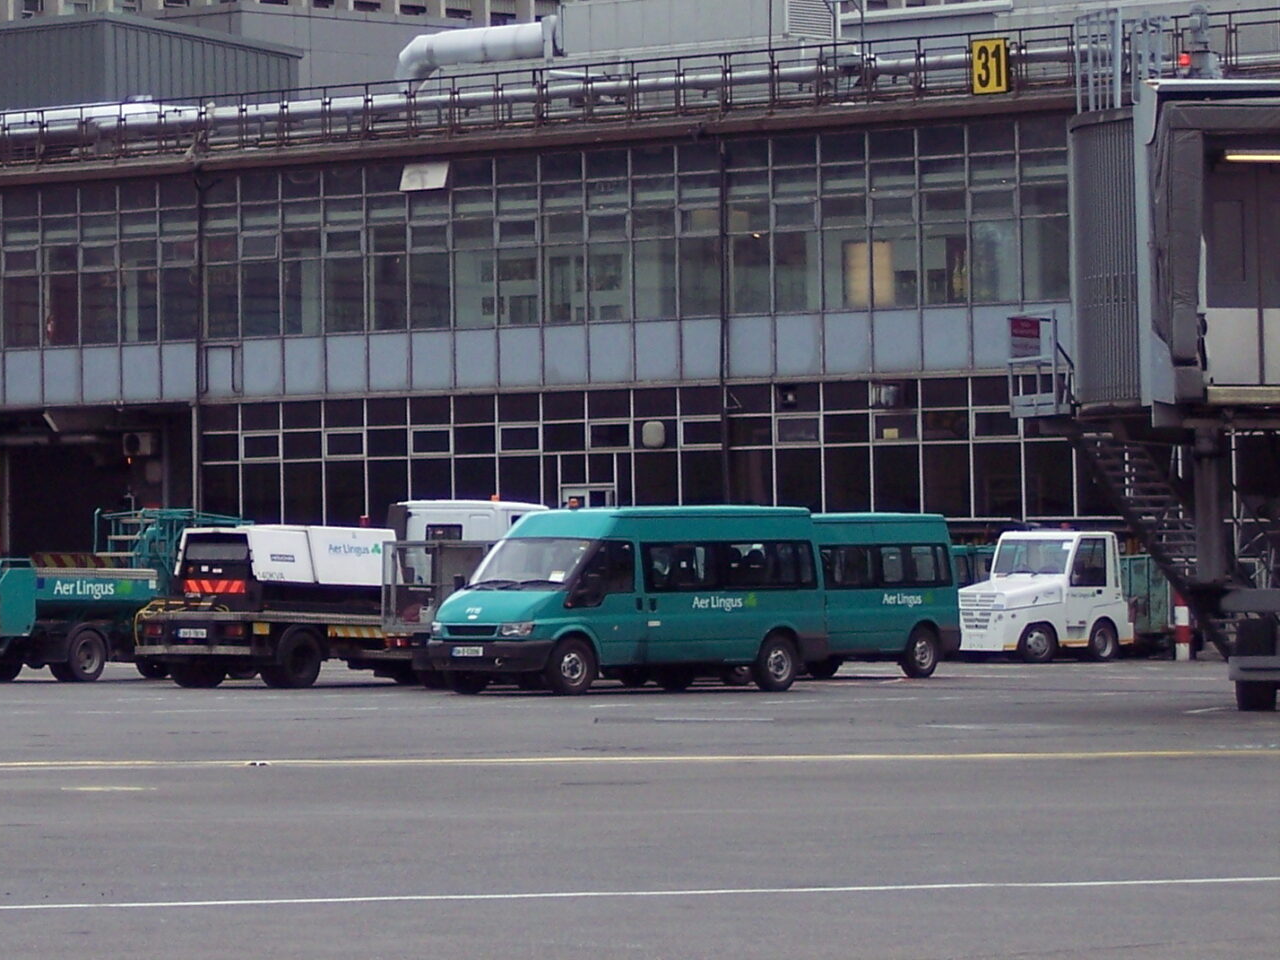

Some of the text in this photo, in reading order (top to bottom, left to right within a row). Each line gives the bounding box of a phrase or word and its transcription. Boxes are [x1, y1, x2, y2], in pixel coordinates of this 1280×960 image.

[977, 43, 1003, 88] 31
[328, 543, 370, 557] Aer Lingus
[53, 580, 115, 599] Aer Lingus
[692, 595, 743, 612] Aer Lingus
[882, 593, 923, 608] Aer Lingus
